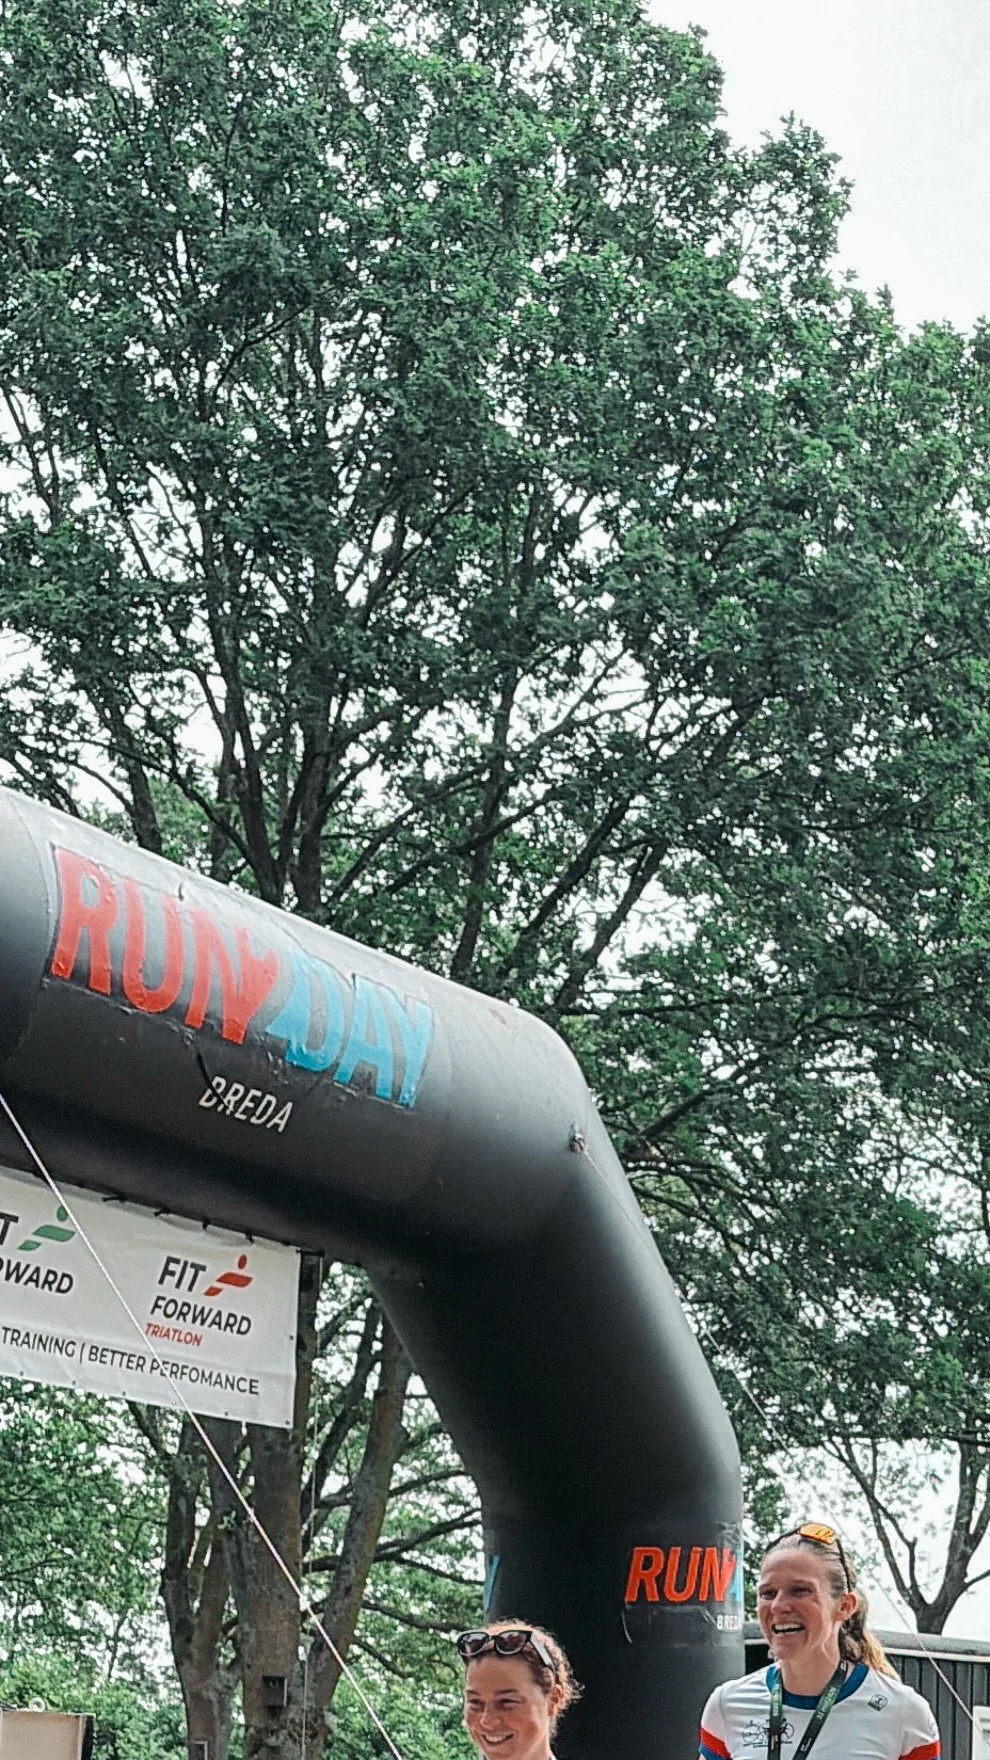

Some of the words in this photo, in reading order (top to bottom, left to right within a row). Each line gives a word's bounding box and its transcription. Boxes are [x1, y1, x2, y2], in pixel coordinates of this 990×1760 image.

[198, 1075, 294, 1132] BREDA
[0, 1256, 74, 1294] WARD
[157, 1255, 206, 1292] FIT
[144, 1322, 203, 1347] TRIATLON
[150, 1295, 252, 1336] FORWARD
[2, 1326, 77, 1357] TRAINING
[88, 1345, 146, 1372] BETTER
[149, 1360, 260, 1396] PERFOMANCE
